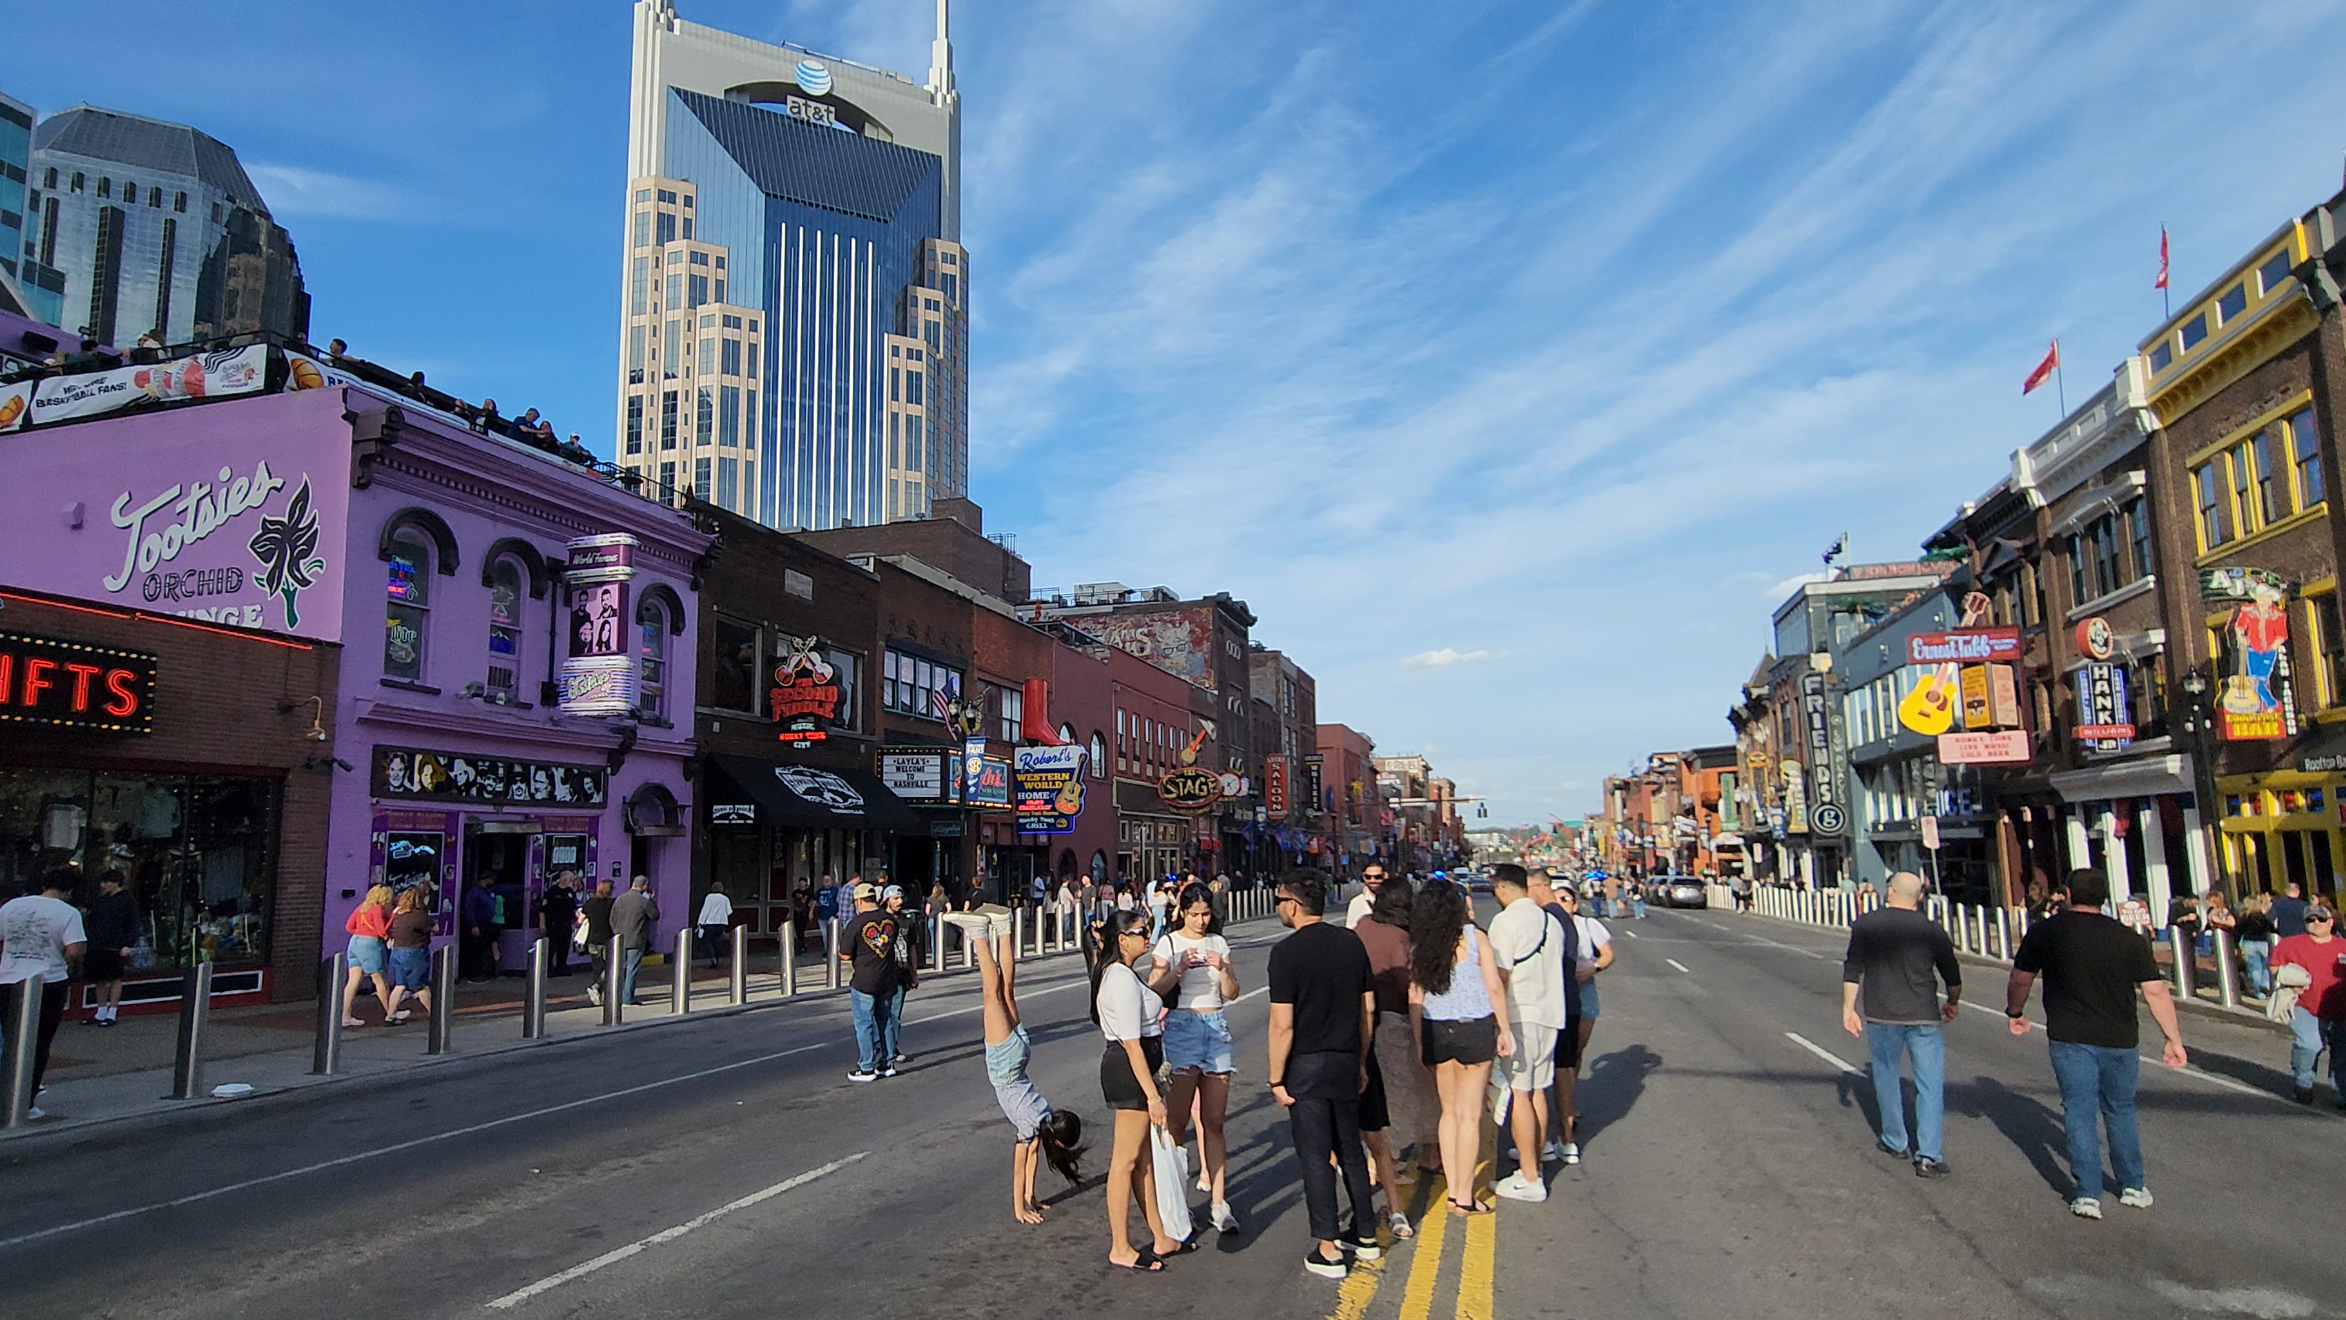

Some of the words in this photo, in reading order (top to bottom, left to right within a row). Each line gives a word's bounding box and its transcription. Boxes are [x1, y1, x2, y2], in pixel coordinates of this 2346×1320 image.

[789, 99, 834, 128] at&t
[97, 382, 127, 395] FANS!
[103, 460, 285, 592] Tootsies
[143, 567, 243, 602] ORCHID
[1912, 637, 1958, 660] Ernest
[1945, 634, 1990, 657] Tubb
[2092, 665, 2113, 725] HANK
[1804, 676, 1832, 803] FRIENDS
[895, 765, 925, 773] WELCOME
[1020, 746, 1072, 774] Robert's
[2304, 756, 2335, 772] Rooftop
[893, 780, 929, 788] NASHVILLE
[1016, 773, 1070, 781] WESTERN
[1024, 781, 1063, 790] WORLD
[1162, 775, 1220, 799] STAGE
[1271, 763, 1282, 810] SALOON
[1017, 791, 1050, 800] HOME
